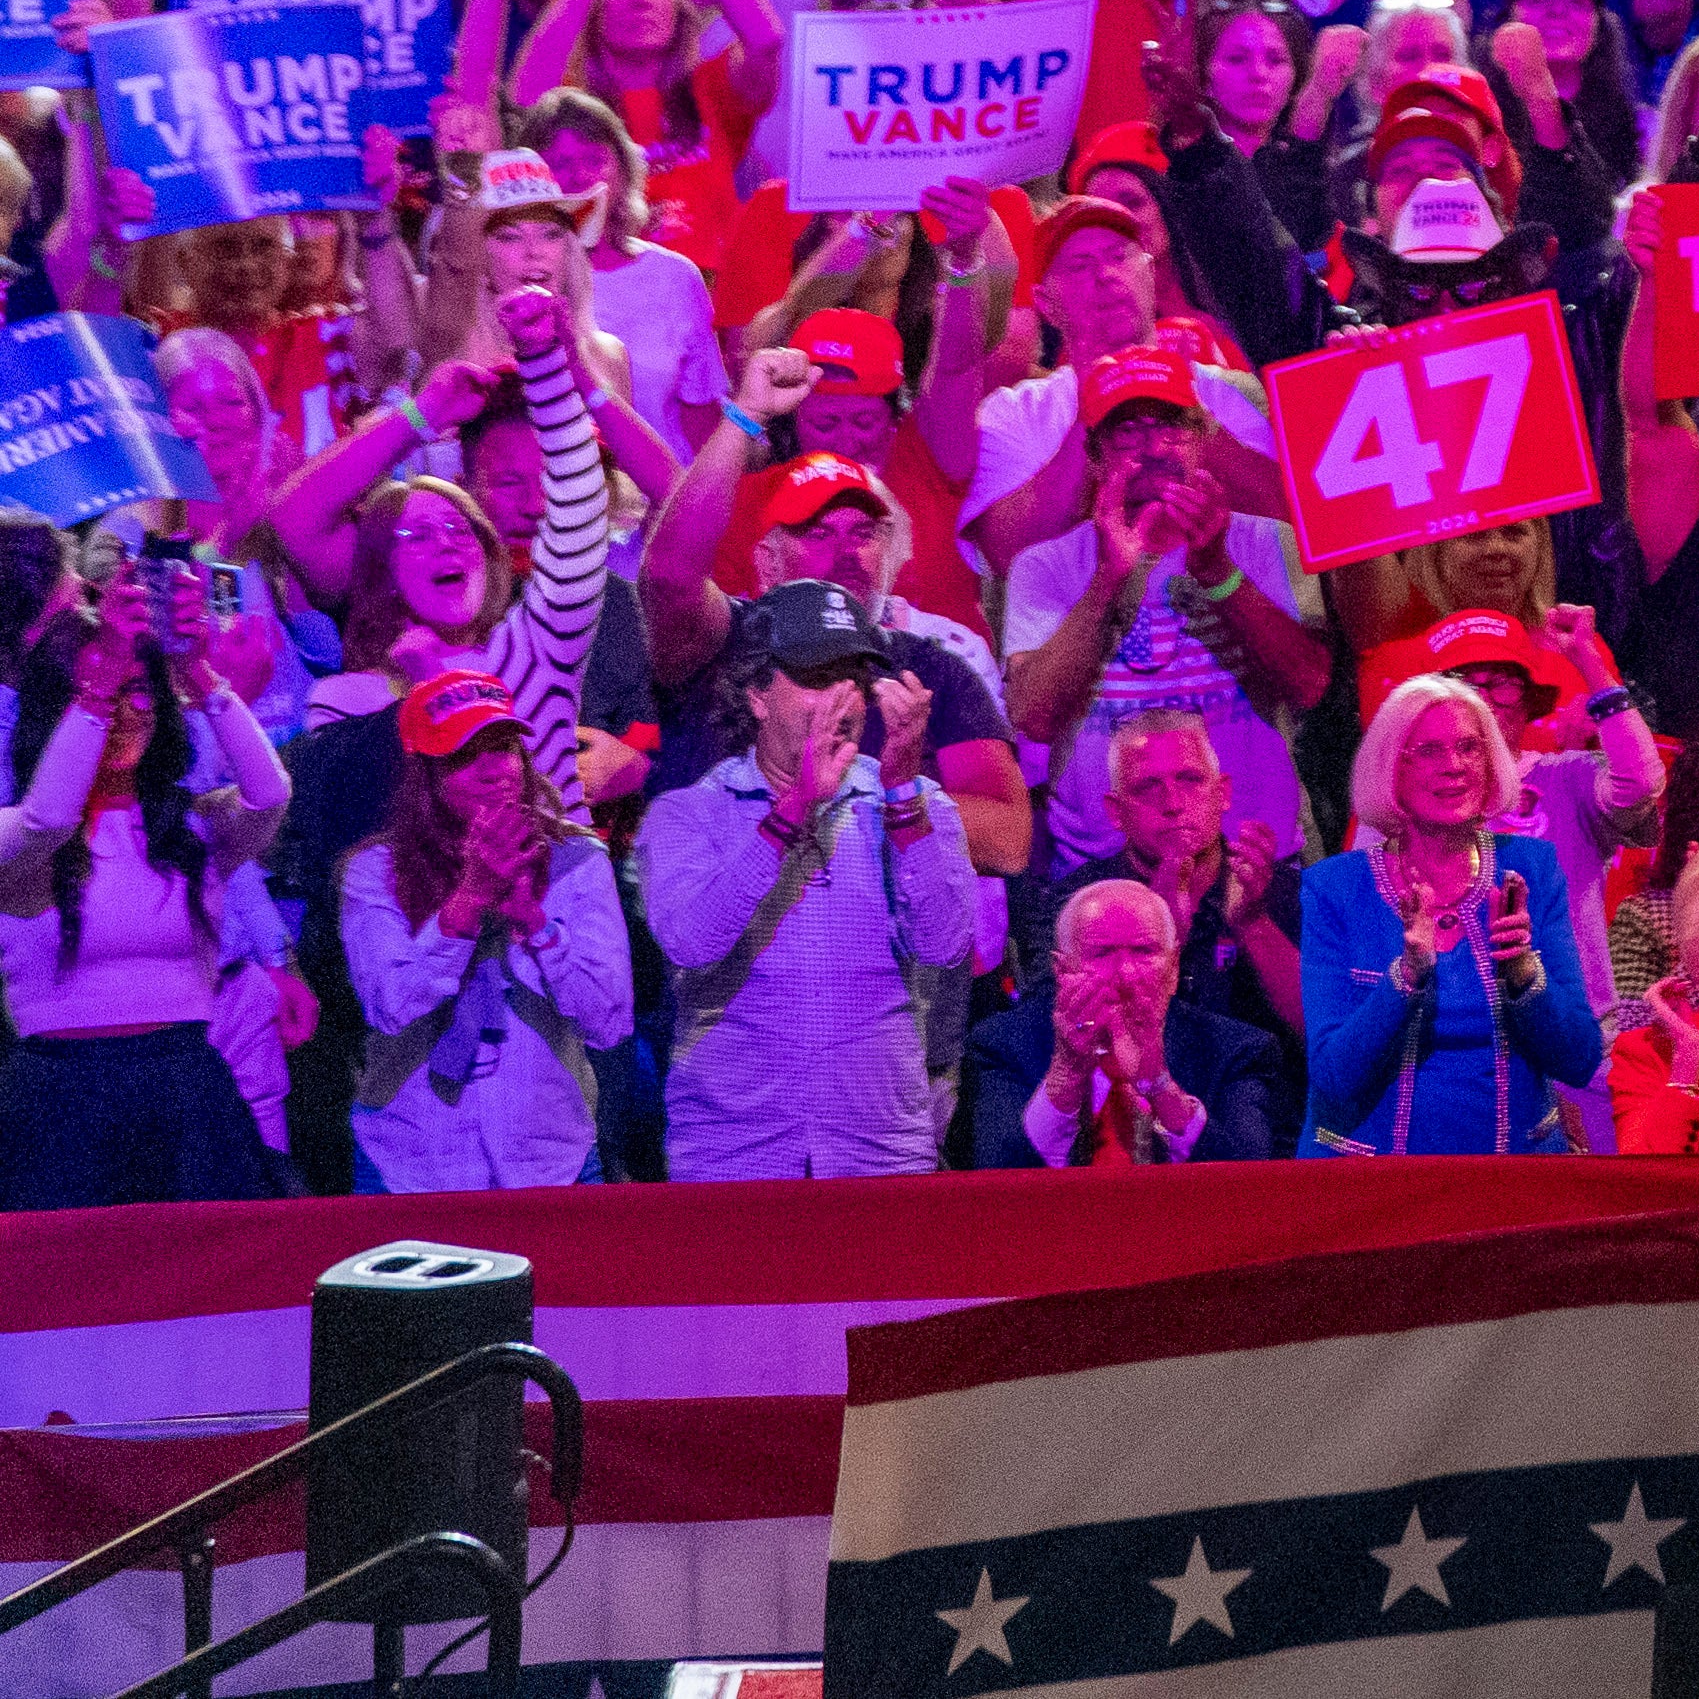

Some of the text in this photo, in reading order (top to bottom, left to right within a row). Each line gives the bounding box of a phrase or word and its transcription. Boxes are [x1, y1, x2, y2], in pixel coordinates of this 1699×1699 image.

[815, 47, 1070, 107] TRUMP
[842, 97, 1042, 145] VANCE
[0, 412, 108, 472] AMERI
[1314, 336, 1533, 510] 47
[1426, 511, 1480, 534] 2024
